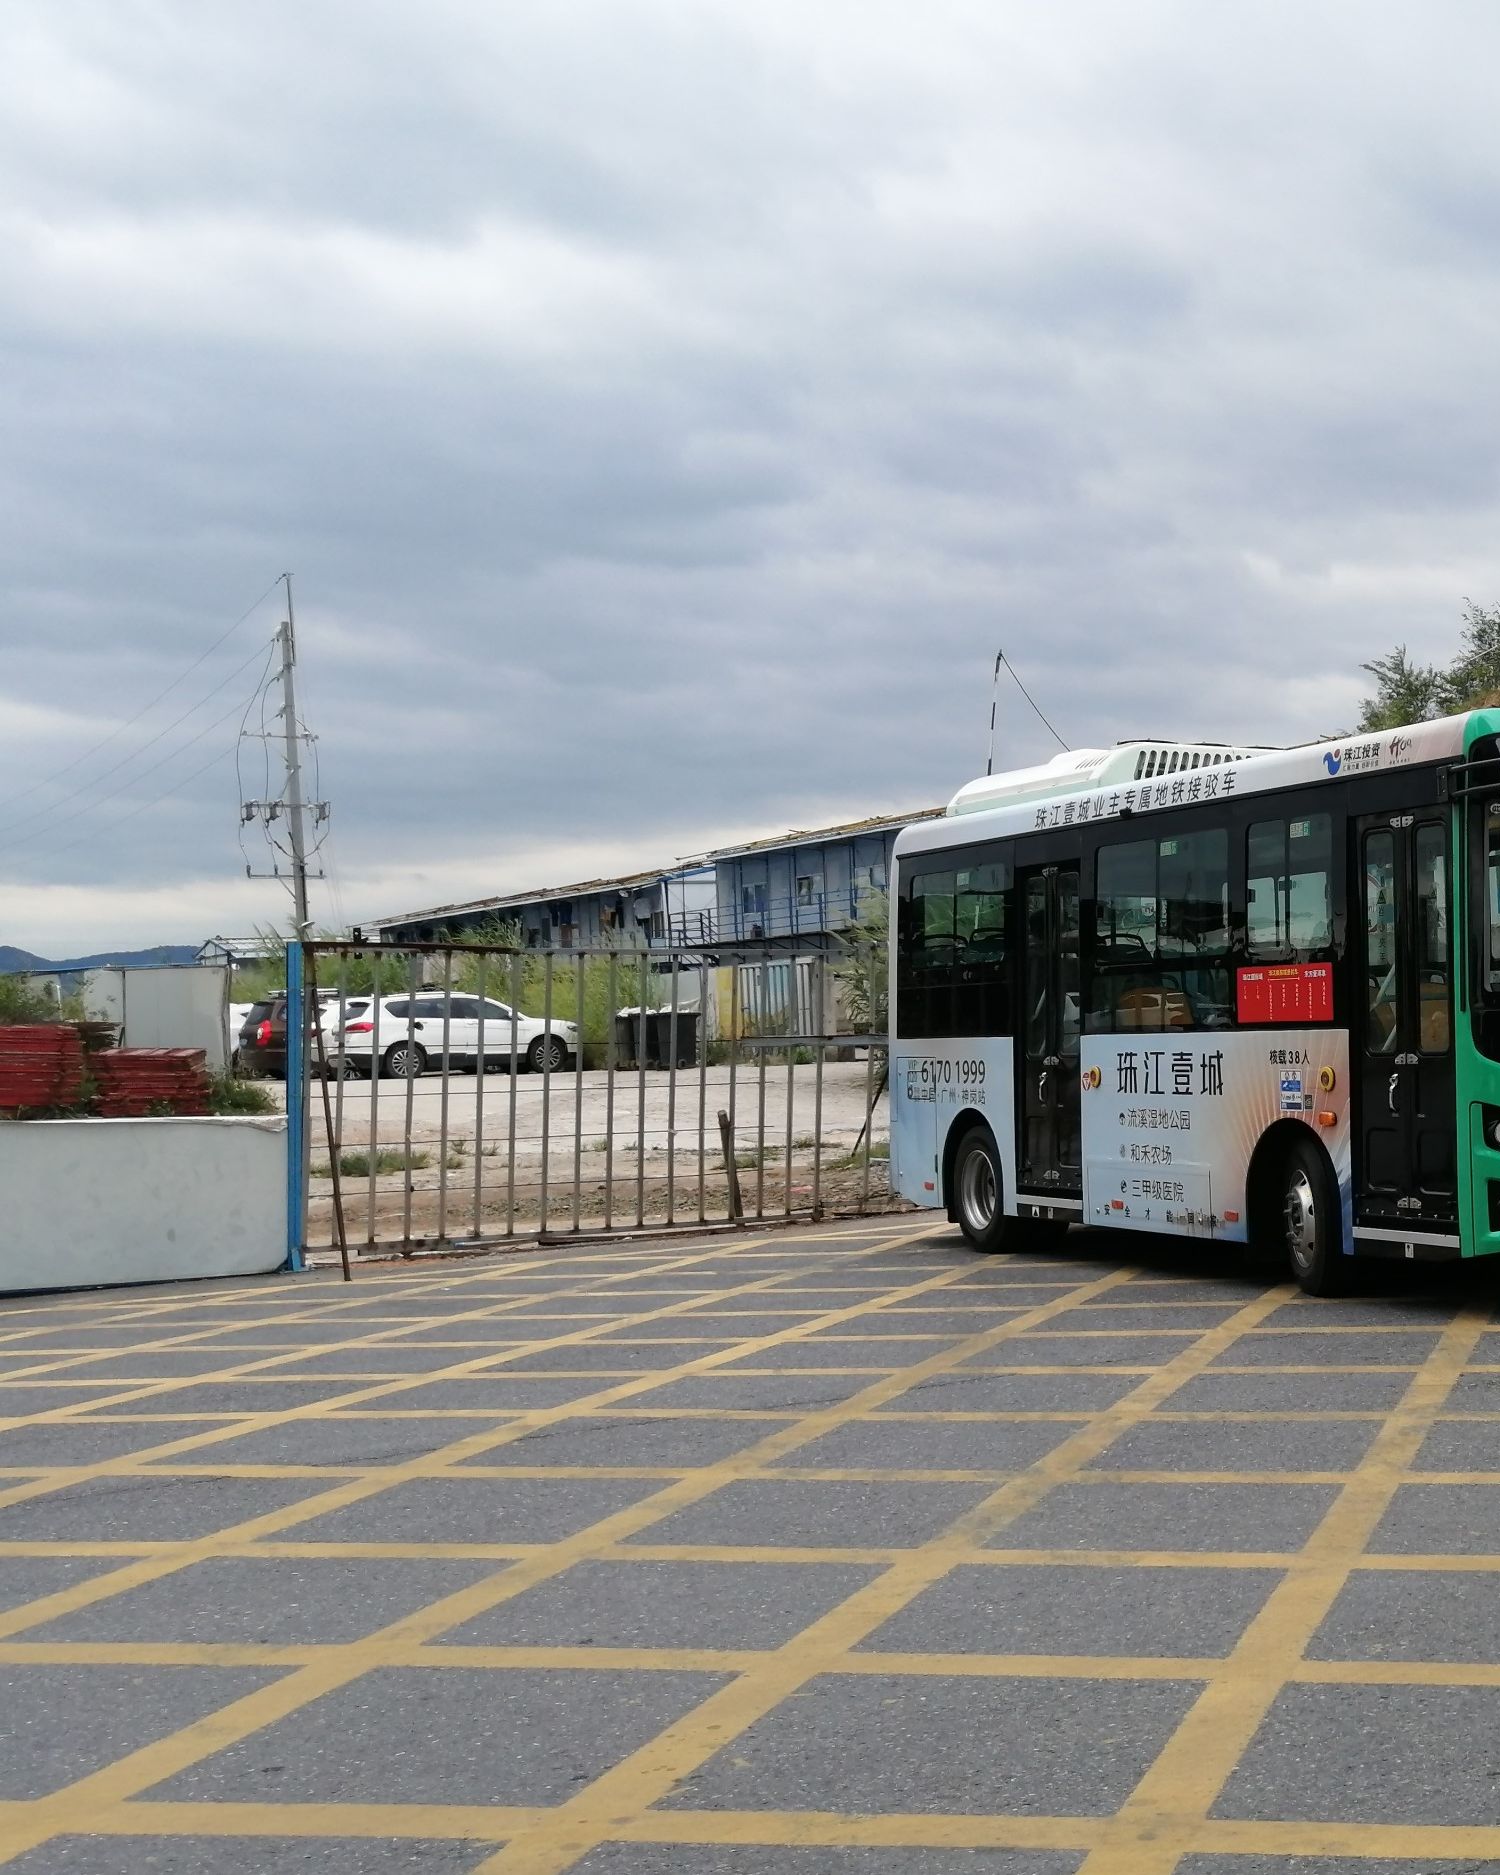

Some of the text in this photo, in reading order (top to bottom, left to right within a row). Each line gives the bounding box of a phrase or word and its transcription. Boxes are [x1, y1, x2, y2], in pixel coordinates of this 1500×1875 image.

[1343, 742, 1381, 761] 珠江投资
[921, 1060, 951, 1084] 6170
[955, 1060, 986, 1085] 1999
[1116, 1050, 1225, 1097] 珠江壹城
[1127, 1108, 1191, 1131] 流溪湿地公园
[1130, 1143, 1173, 1165] 和禾农场
[1131, 1179, 1185, 1203] 三甲级医院
